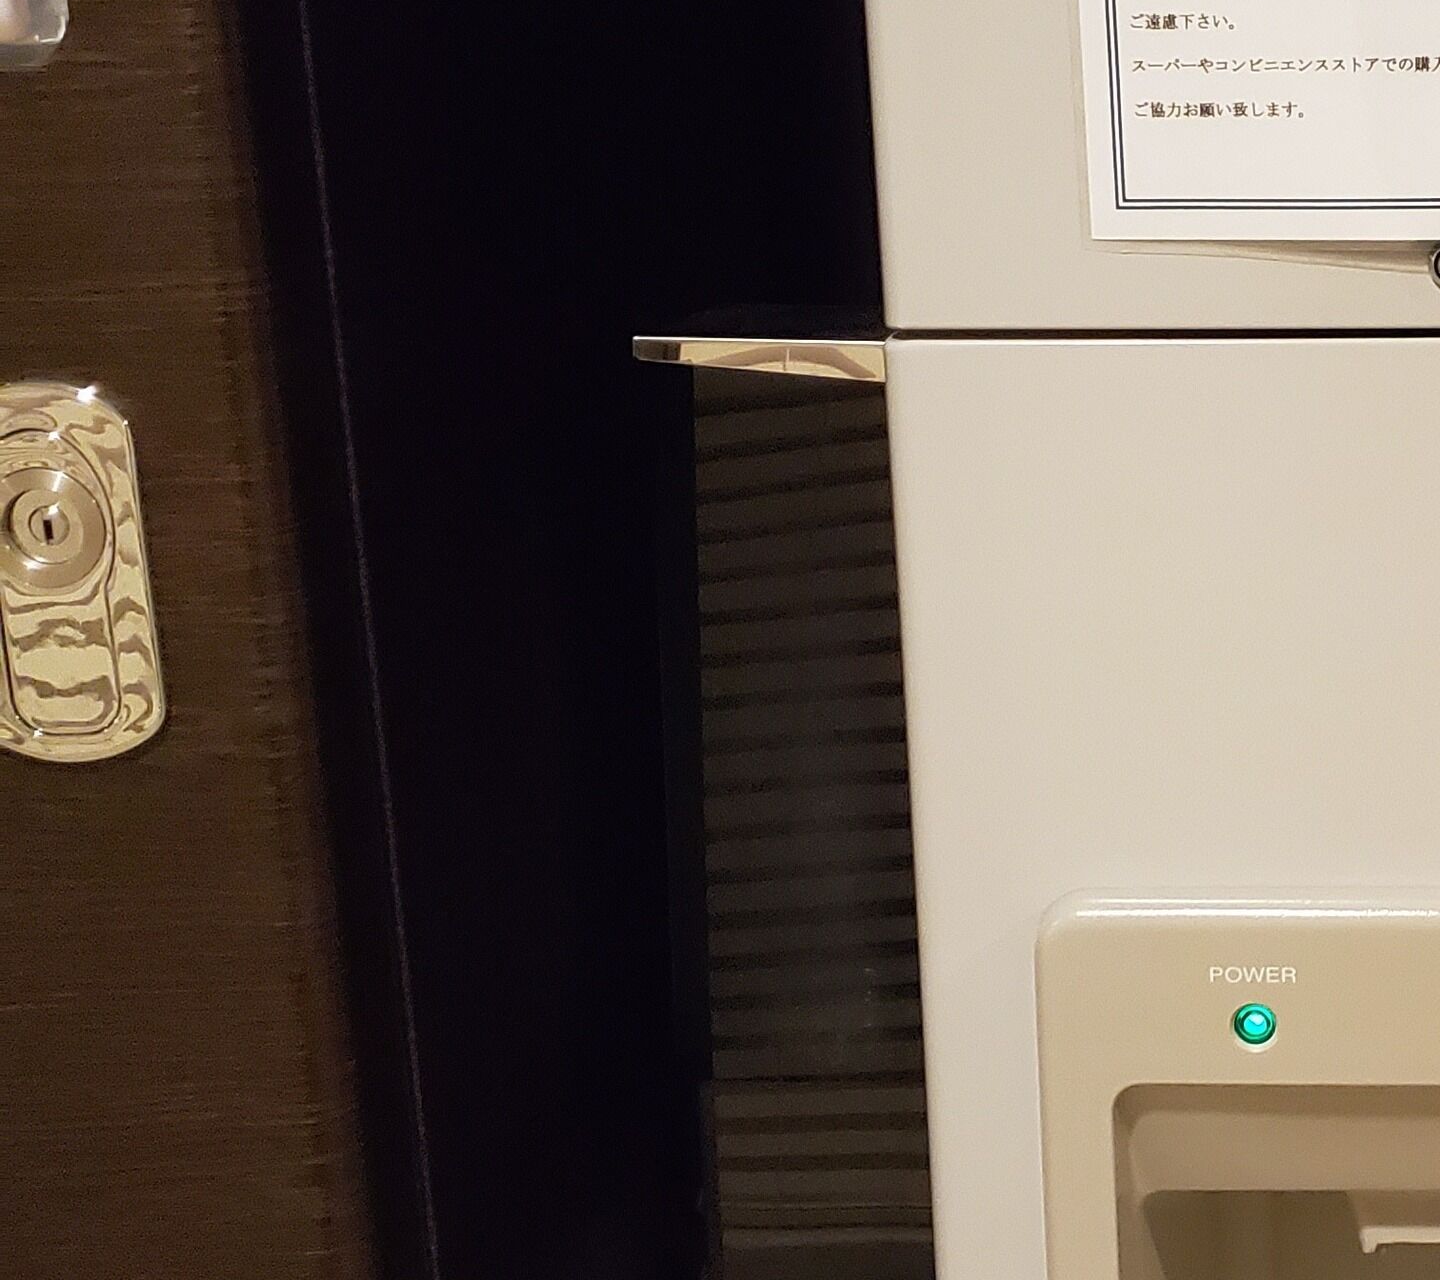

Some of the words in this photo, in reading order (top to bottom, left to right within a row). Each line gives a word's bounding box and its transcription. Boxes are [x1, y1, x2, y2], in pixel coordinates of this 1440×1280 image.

[1129, 13, 1238, 31] ご遠慮下さい。
[1133, 101, 1306, 120] ご協力お願い致します。
[1209, 966, 1297, 983] POWER
